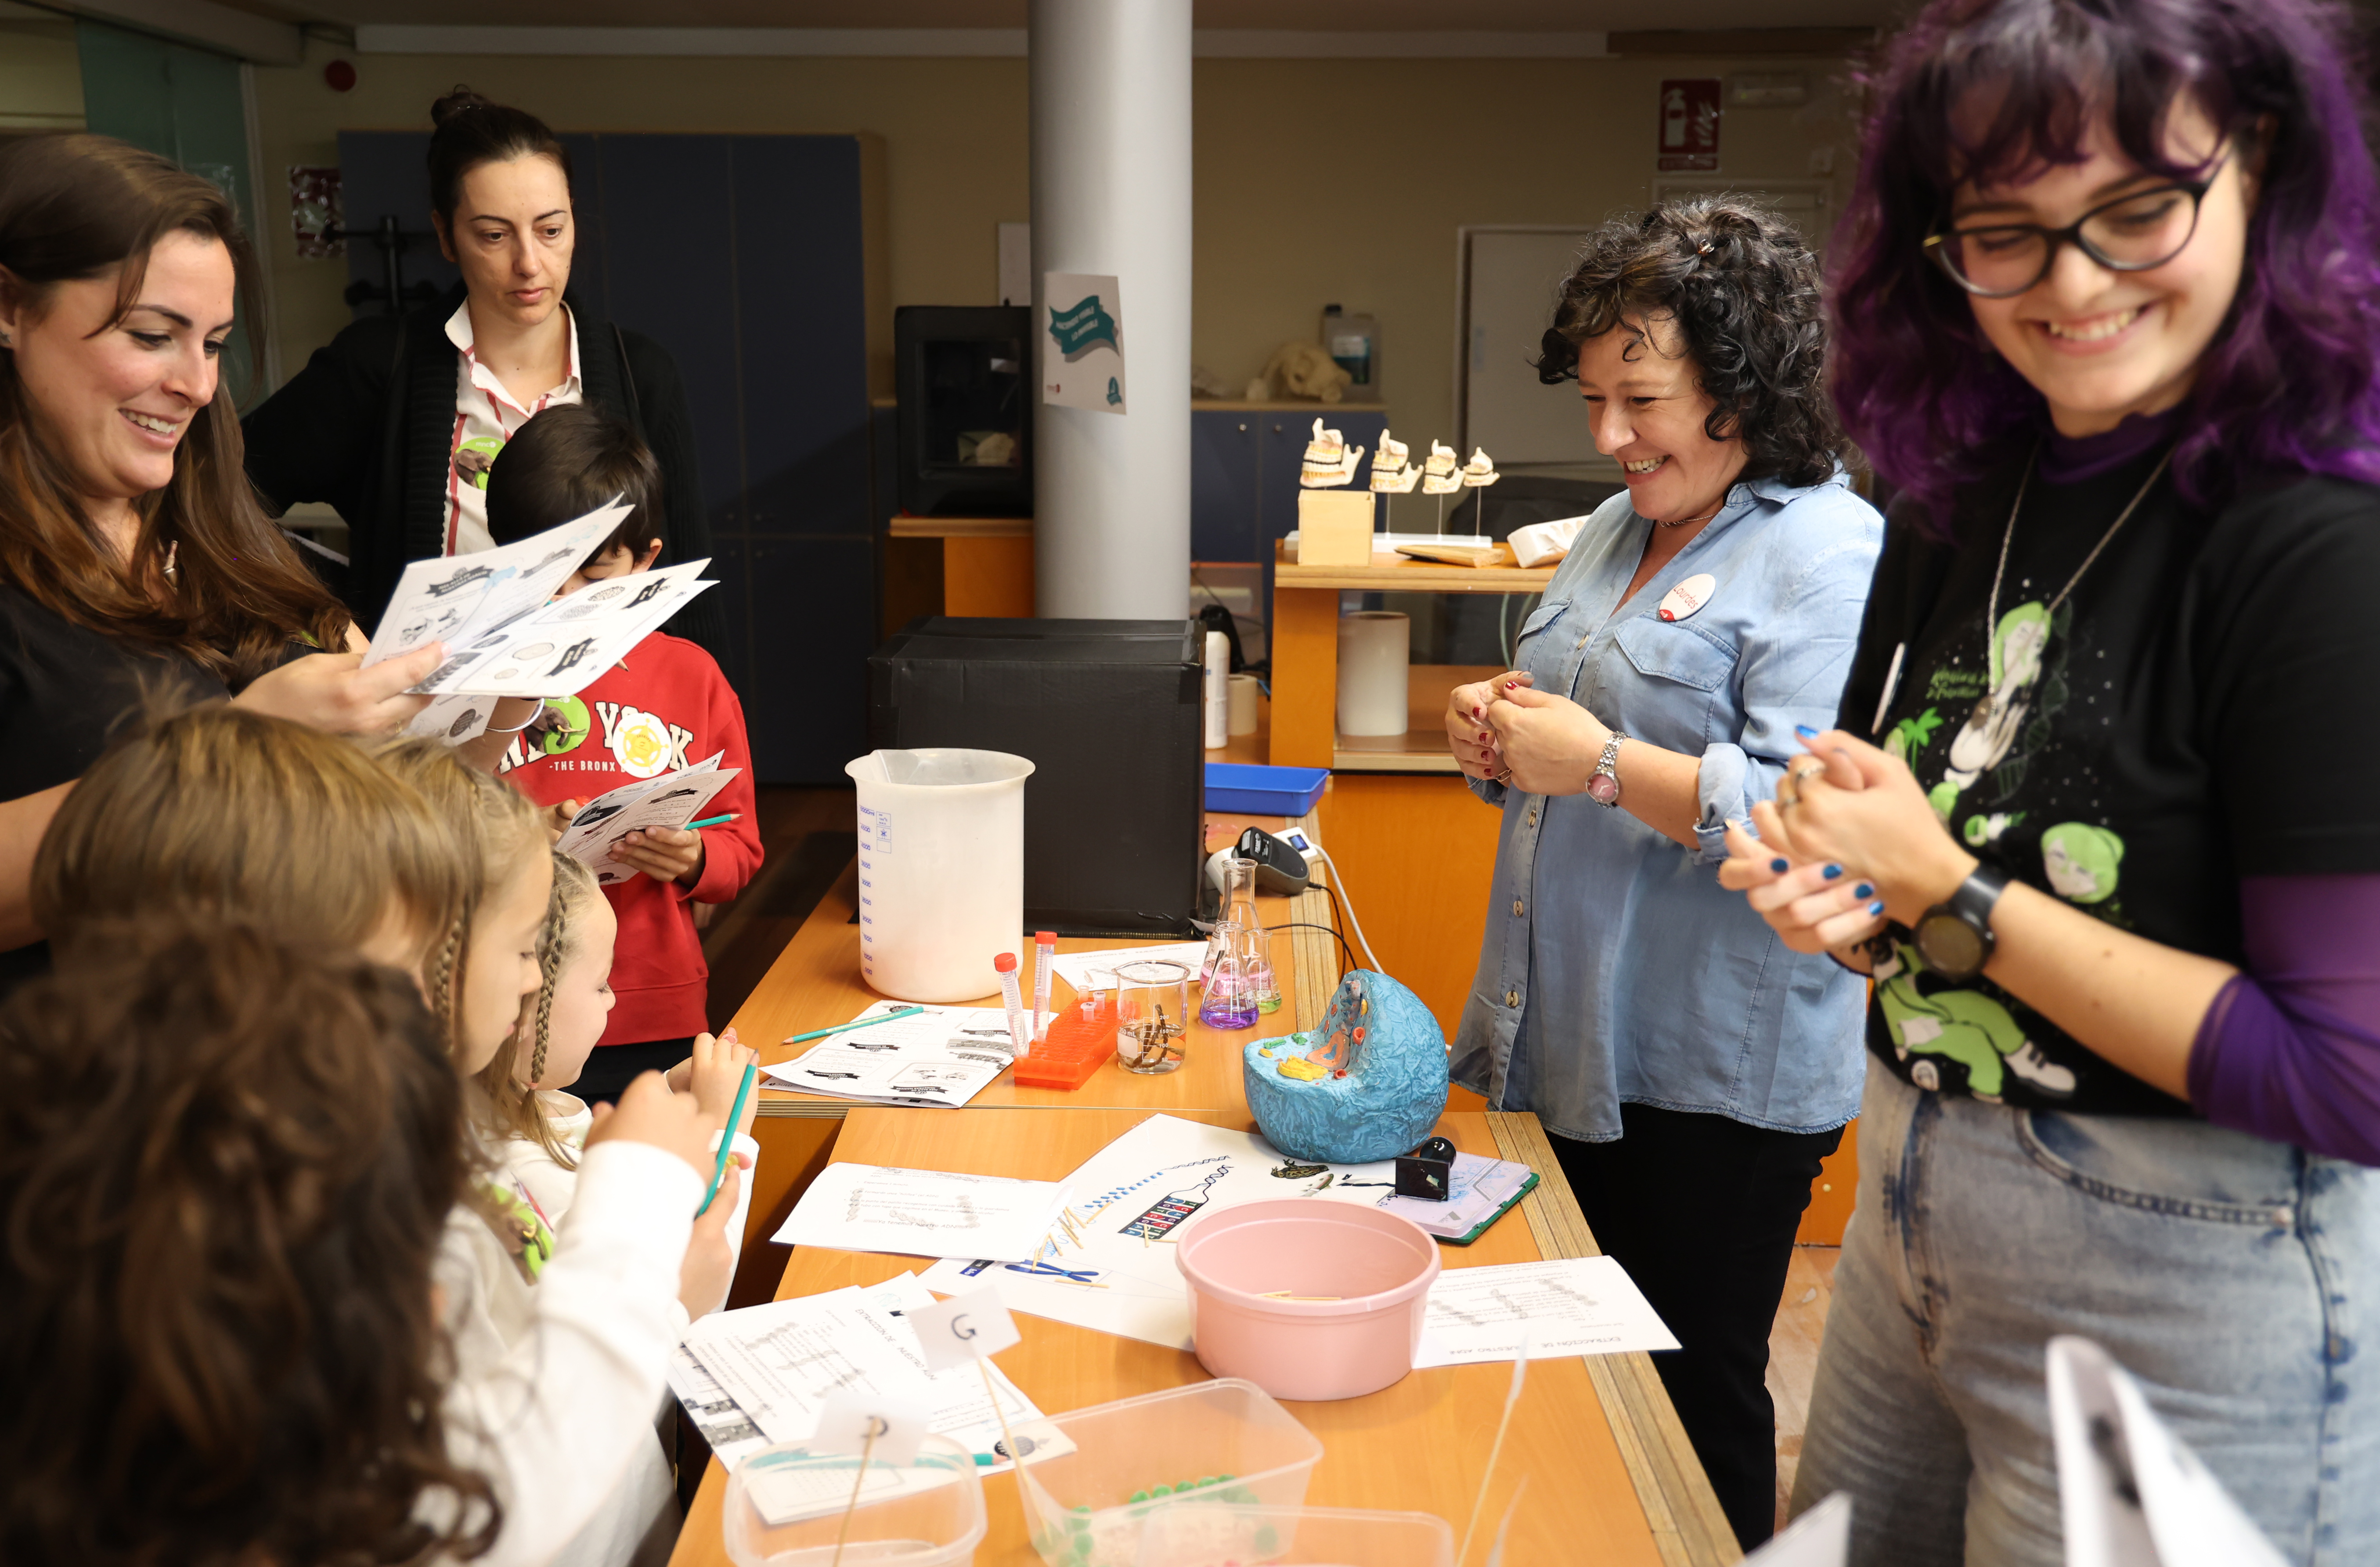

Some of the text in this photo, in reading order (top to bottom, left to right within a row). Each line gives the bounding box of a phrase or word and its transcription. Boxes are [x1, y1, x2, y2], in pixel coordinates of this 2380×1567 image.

[1673, 582, 1698, 609] Lourdes
[595, 701, 694, 772] YK
[580, 761, 616, 772] BRONX
[860, 806, 875, 816] 5000ml
[855, 1307, 887, 1336] EXTRACCIÓN
[884, 1333, 894, 1343] DE
[951, 1313, 978, 1340] G
[1557, 1336, 1622, 1347] EXTRACCIÓN
